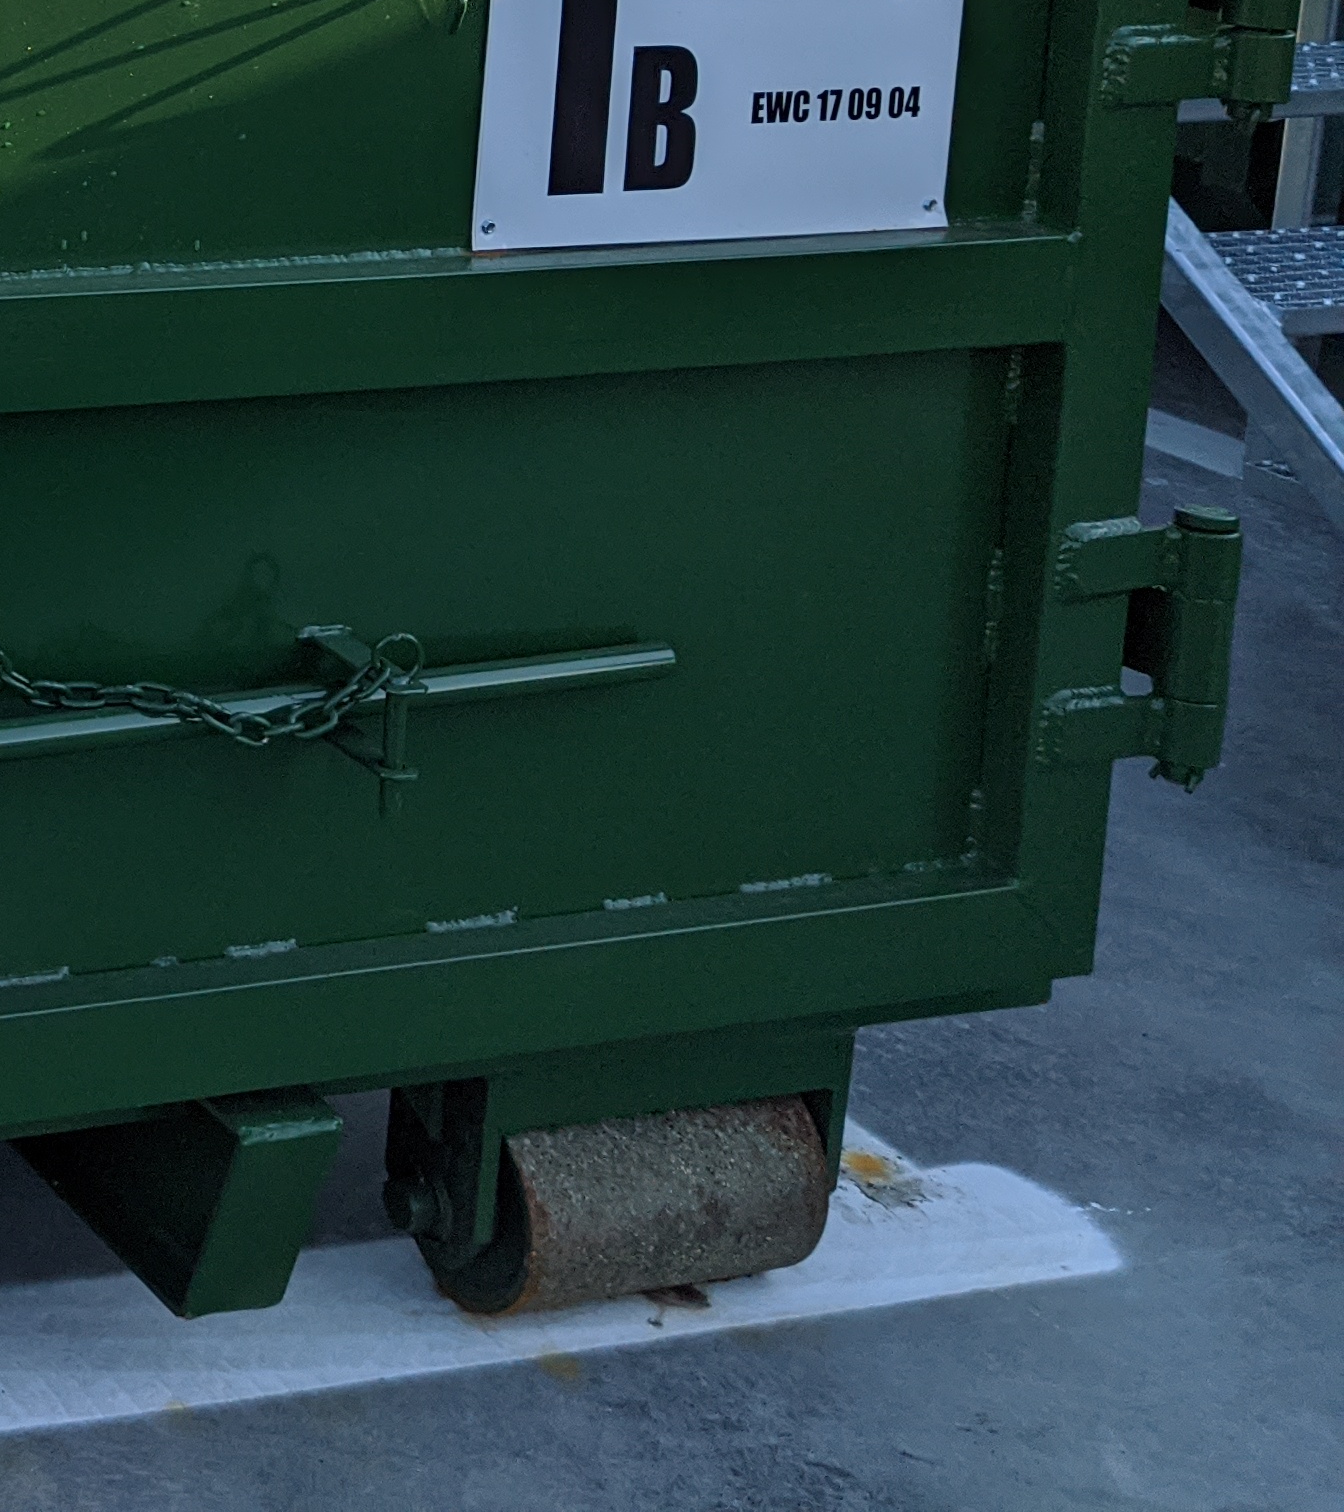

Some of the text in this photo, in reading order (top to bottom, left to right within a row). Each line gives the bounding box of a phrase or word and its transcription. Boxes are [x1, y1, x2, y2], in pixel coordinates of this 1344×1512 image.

[750, 85, 921, 124] EWC 17 09 04
